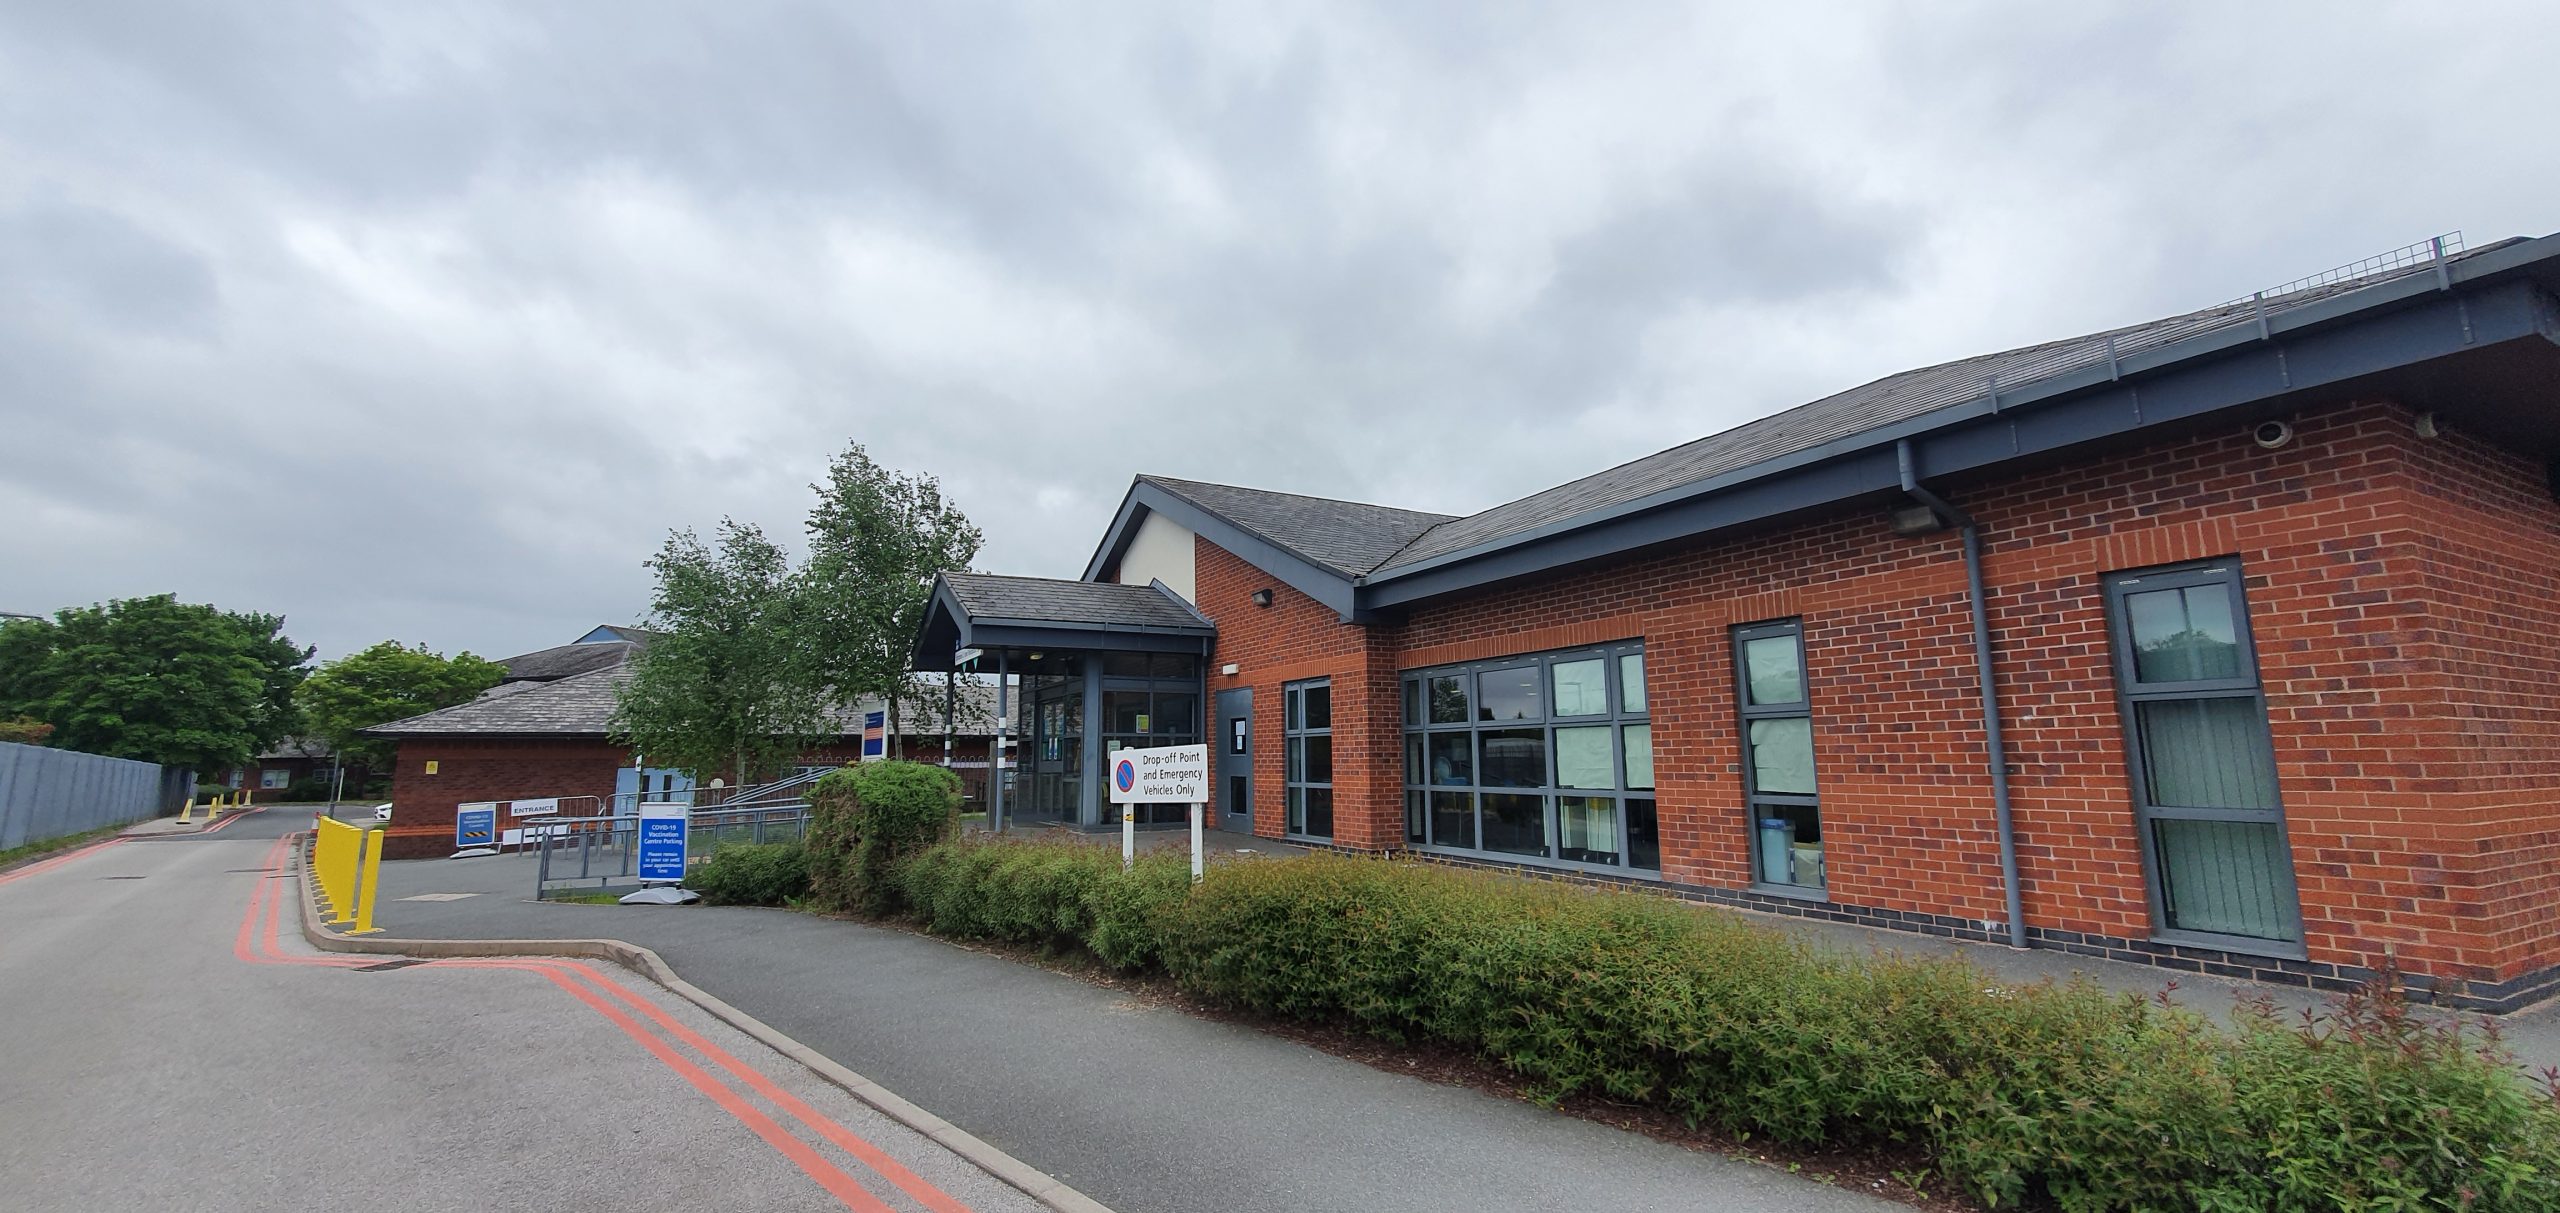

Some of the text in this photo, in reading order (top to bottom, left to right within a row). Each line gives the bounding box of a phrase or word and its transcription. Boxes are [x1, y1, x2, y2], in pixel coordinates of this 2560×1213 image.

[1143, 751, 1200, 766] Drop-off Point
[1143, 768, 1203, 782] and Emergency
[1143, 783, 1195, 797] Vehicles Only
[514, 805, 555, 814] ENTRANCE
[663, 838, 683, 846] Parking
